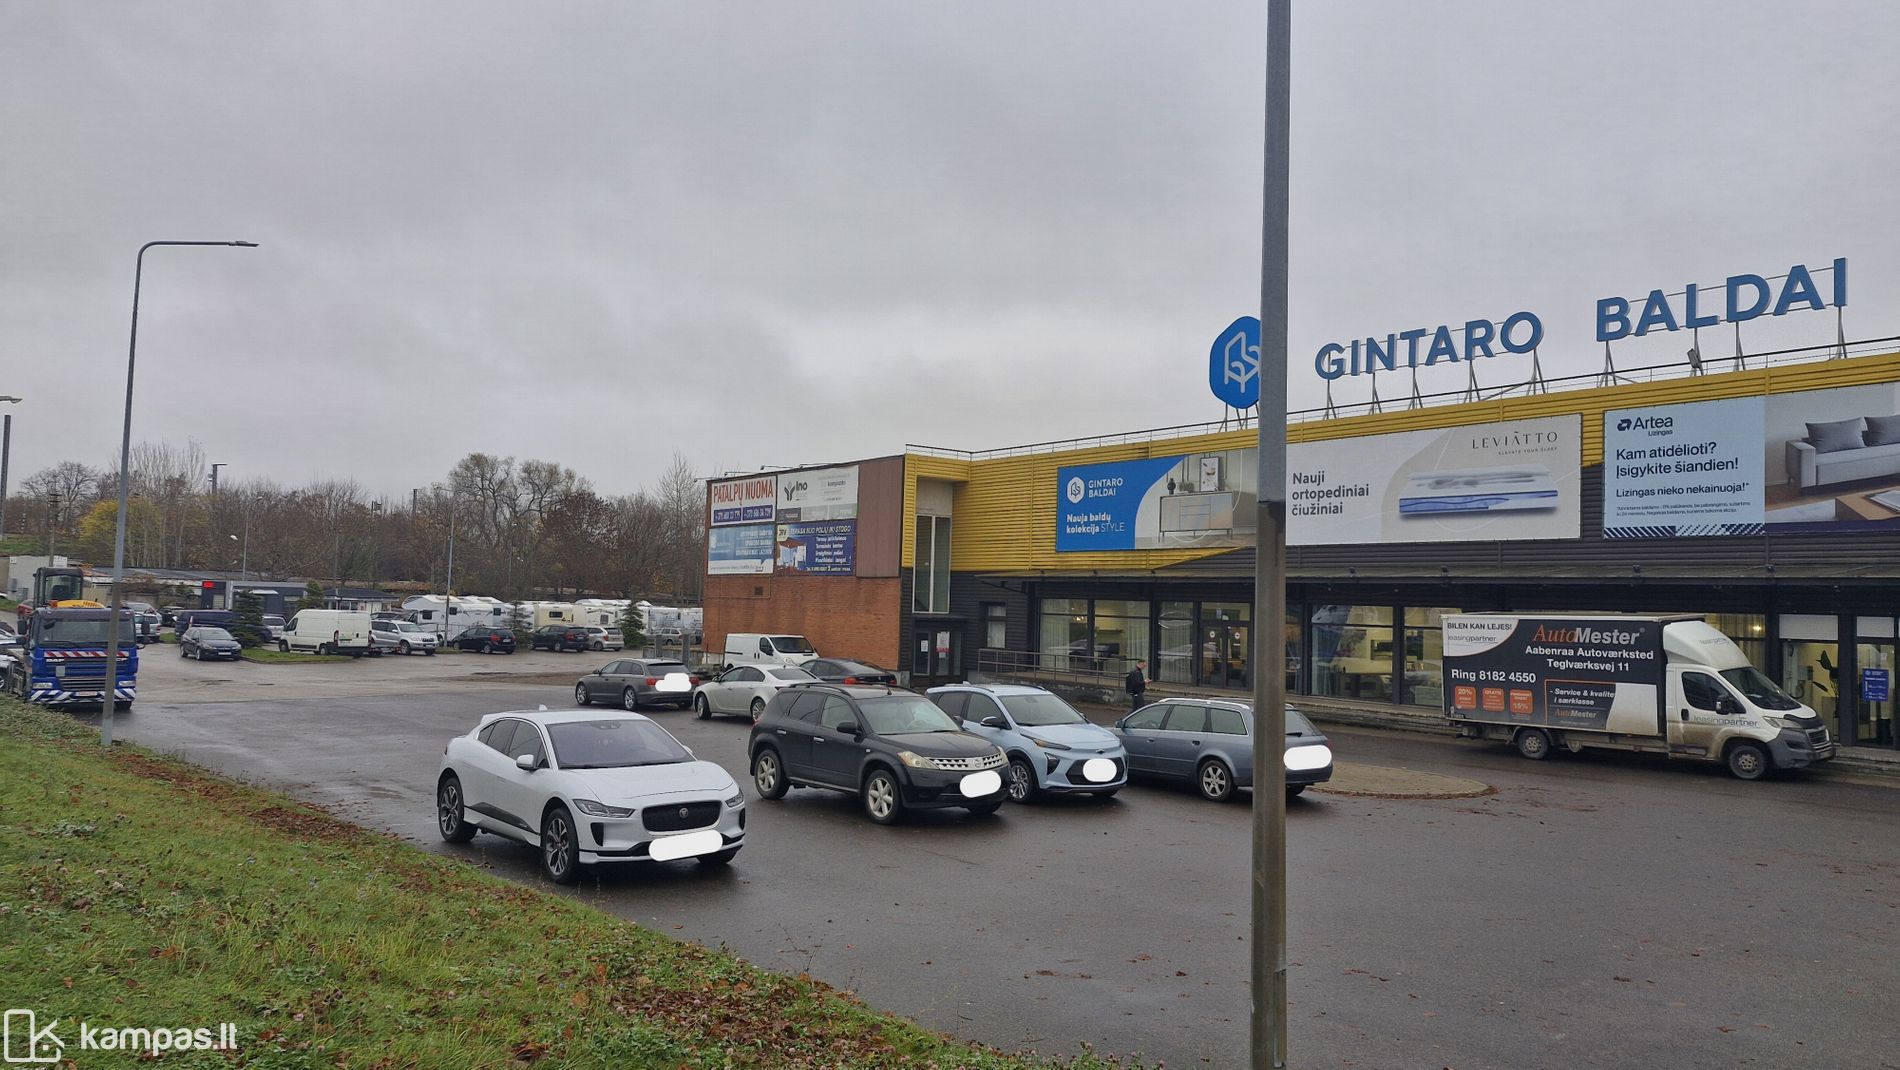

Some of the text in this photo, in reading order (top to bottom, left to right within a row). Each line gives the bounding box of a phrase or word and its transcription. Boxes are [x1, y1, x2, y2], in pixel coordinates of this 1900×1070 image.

[1315, 257, 1848, 381] GINTARO BALDAI
[1633, 416, 1673, 430] Artea
[1648, 429, 1673, 437] Lizingas
[1616, 441, 1717, 460] Kam atidėlioti?
[1616, 457, 1739, 479] Įsigykite šiandien!
[1088, 477, 1124, 489] GINTARO
[1292, 471, 1325, 486] Nauji
[713, 479, 774, 506] PATALPŲ NUOMA
[1088, 488, 1116, 498] BALDAI
[1292, 483, 1369, 501] ortopediniai
[1616, 488, 1656, 498] Lizingas
[1657, 486, 1684, 496] nieko
[1291, 501, 1343, 516] čiužiniai
[1066, 512, 1111, 524] Nauja baldų
[1066, 522, 1125, 535] kolekcija STYLE
[1487, 623, 1512, 631] LEJES!
[1525, 645, 1654, 660] Aabenraa Autoværksted
[1547, 659, 1629, 673] Teglværksvej 11
[1451, 669, 1536, 683] Ring 8182 4550
[1554, 688, 1582, 696] Service
[1693, 715, 1758, 727] leasingpartner
